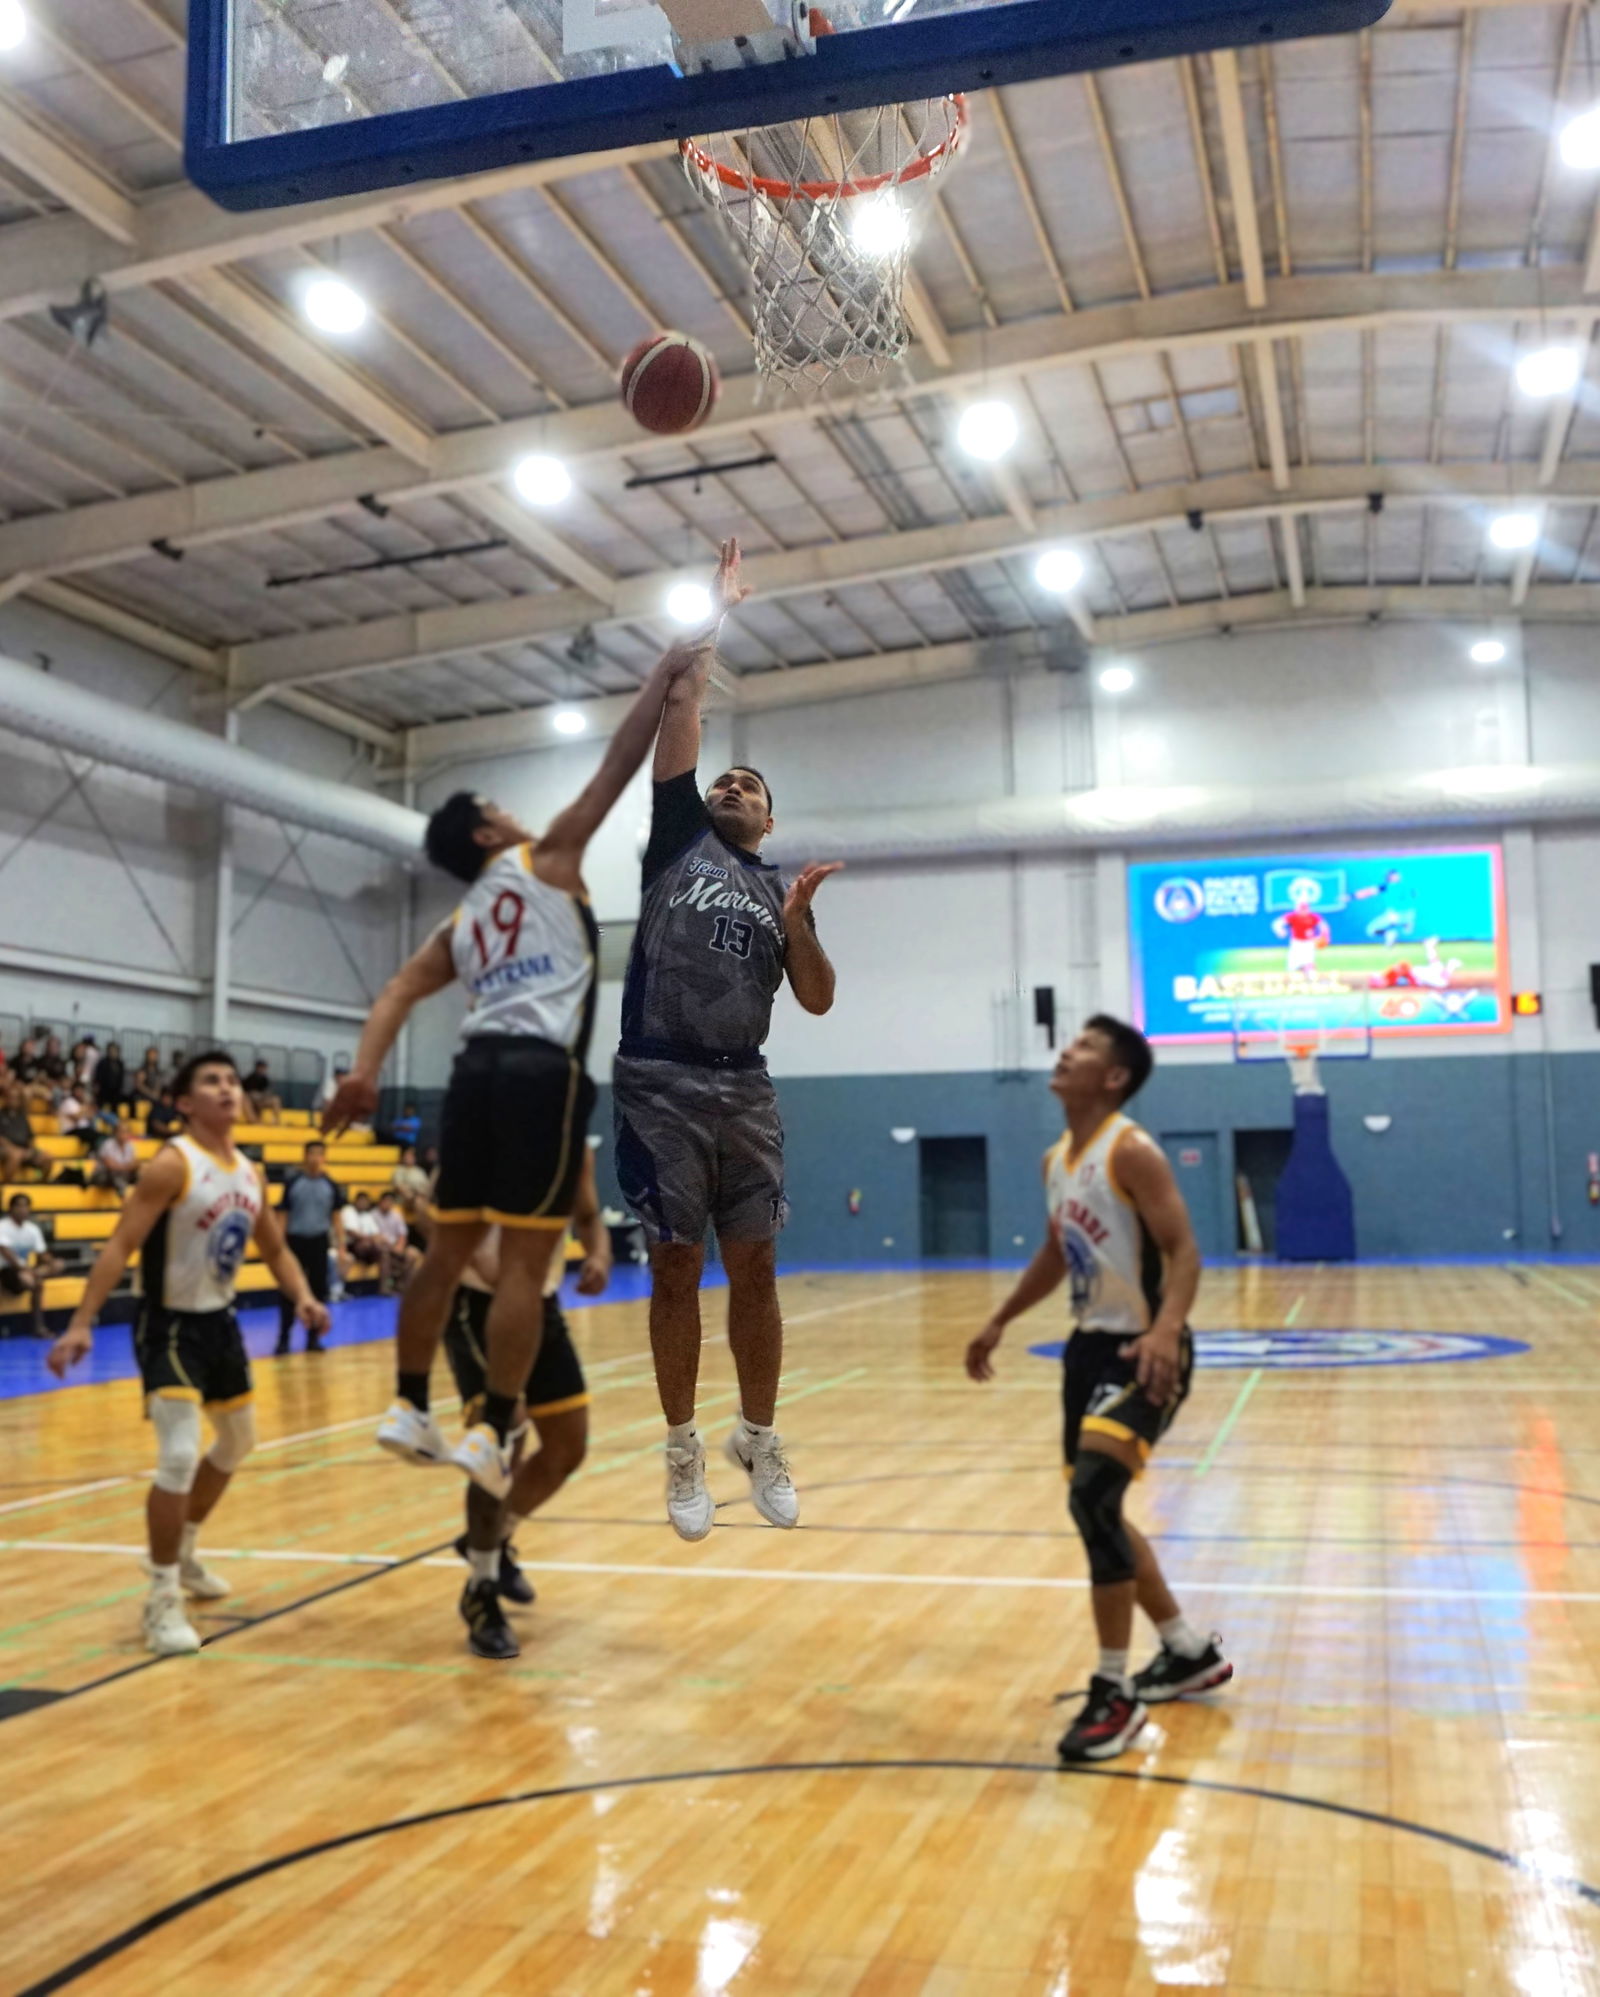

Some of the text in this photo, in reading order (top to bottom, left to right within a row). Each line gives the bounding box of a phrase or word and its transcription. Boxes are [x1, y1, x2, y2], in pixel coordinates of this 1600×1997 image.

[688, 857, 728, 880] Team
[472, 888, 525, 968] 19
[709, 915, 753, 960] 13
[1174, 971, 1350, 1001] BASEBALL
